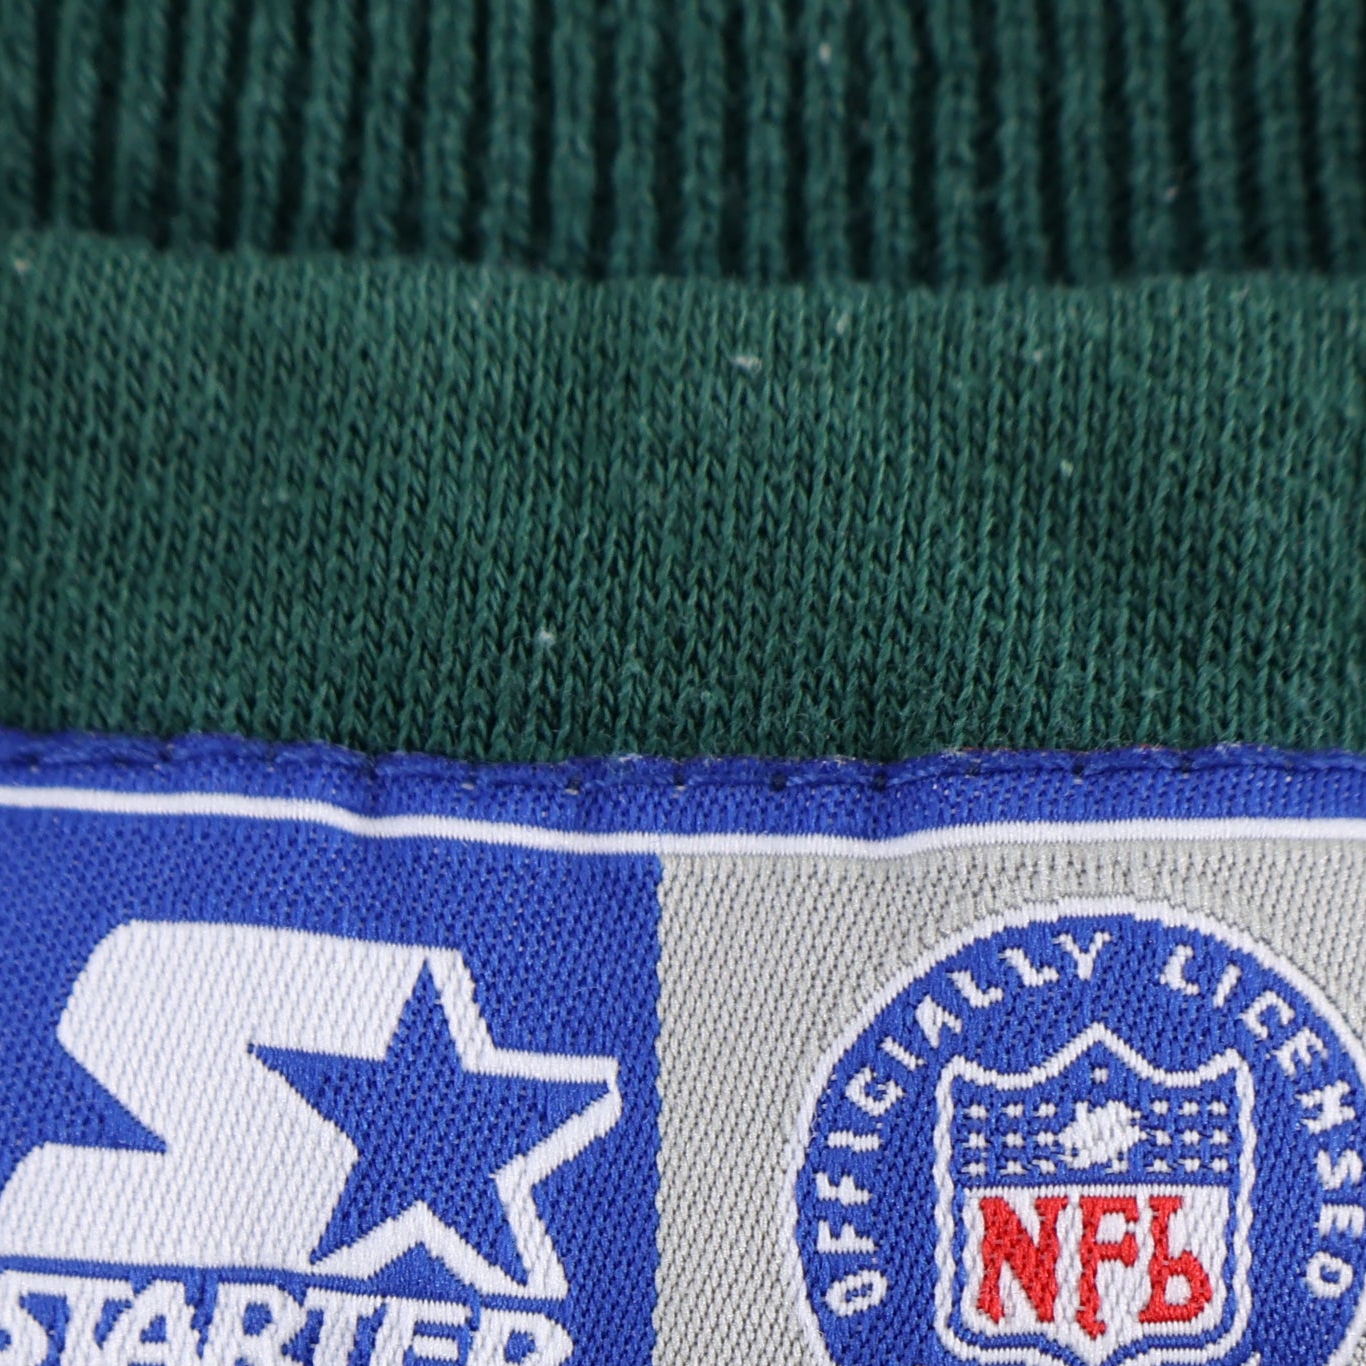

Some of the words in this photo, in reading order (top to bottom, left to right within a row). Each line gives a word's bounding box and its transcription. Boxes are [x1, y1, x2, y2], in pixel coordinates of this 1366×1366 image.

[815, 930, 1112, 1317] OFFICIALLY
[1158, 944, 1366, 1300] LICENSED
[975, 1194, 1214, 1340] NFL
